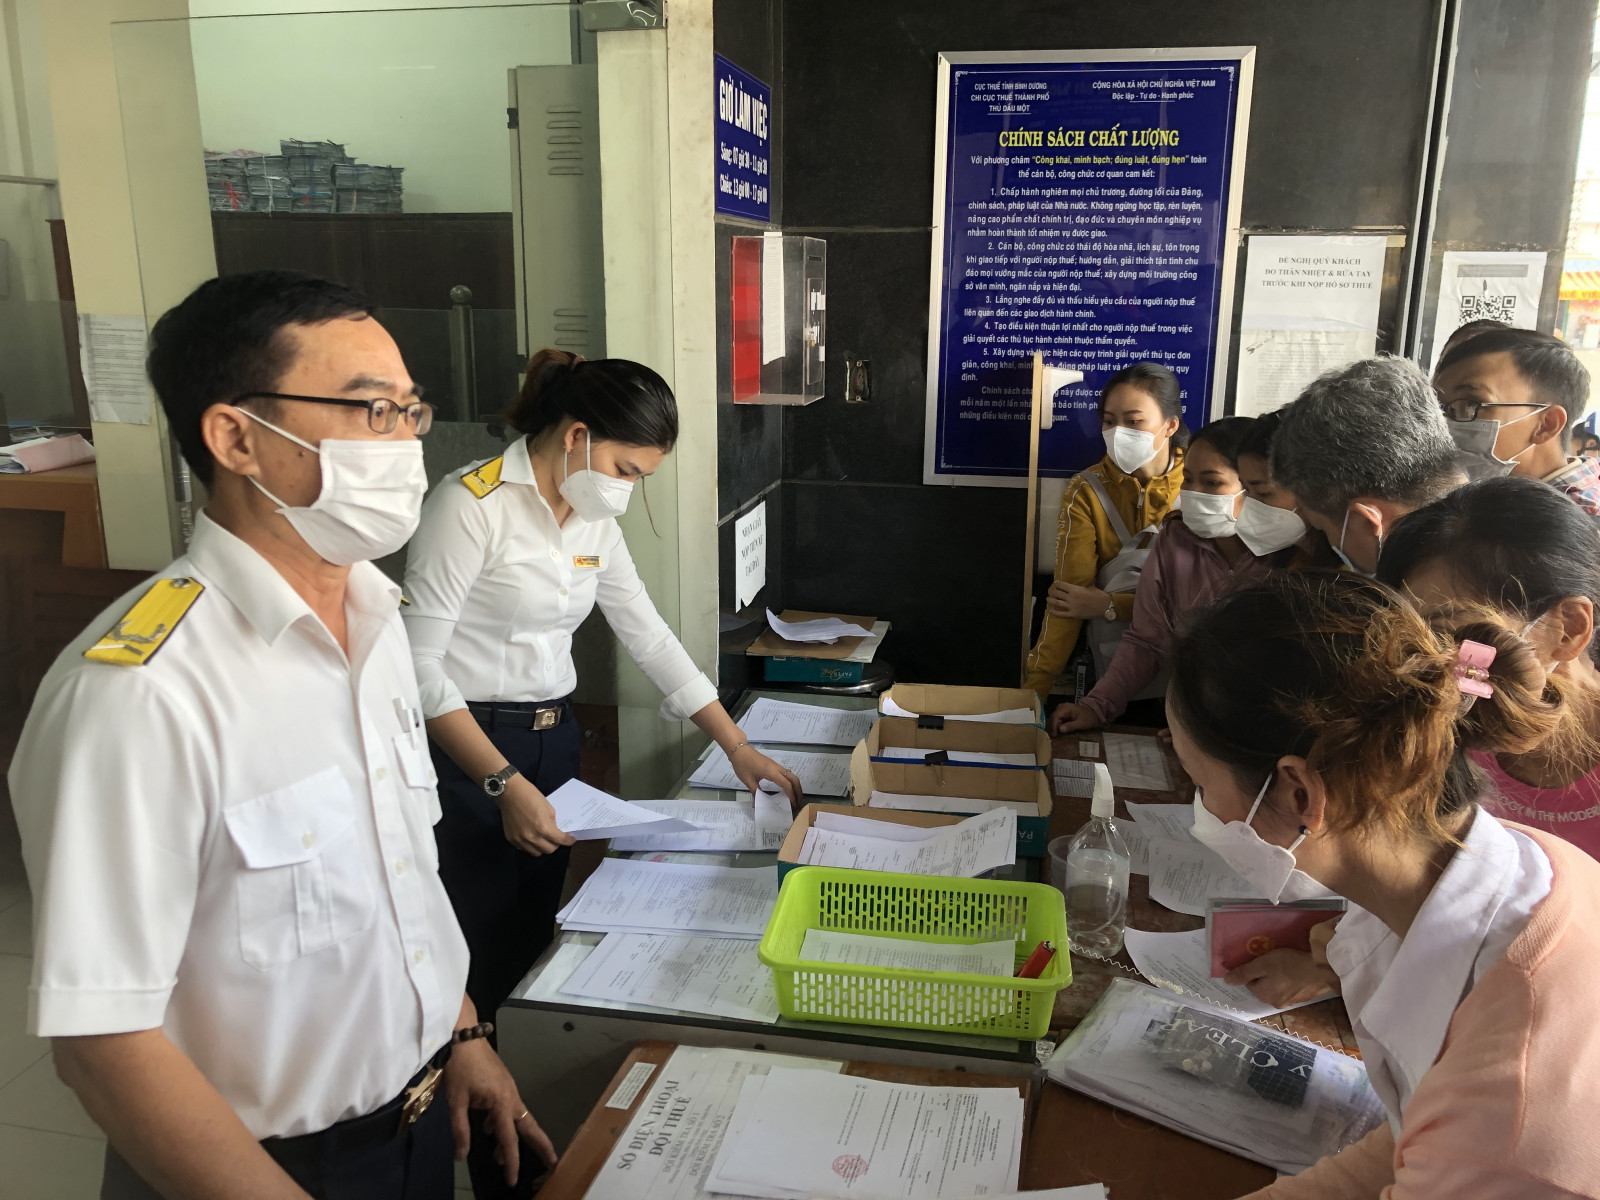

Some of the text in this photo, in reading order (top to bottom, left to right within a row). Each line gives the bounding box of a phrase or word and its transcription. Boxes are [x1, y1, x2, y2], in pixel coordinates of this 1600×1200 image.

[1092, 80, 1110, 89] CỘNG
[1112, 81, 1125, 89] HÒA
[1126, 79, 1135, 88] XÃ
[1136, 79, 1148, 89] HỘI
[1149, 79, 1163, 88] CHỦ
[1164, 79, 1184, 88] NGHĨA
[1185, 78, 1200, 88] VIỆT
[719, 74, 768, 147] GIỜ LÀM VIỆC
[998, 124, 1179, 149] CHÍNH SÁCH CHẤT LƯỢNG
[967, 226, 1107, 239] nhằm hoàn thành tốt nhiệm vụ được giao.
[1291, 258, 1311, 266] NGHỊ
[1332, 257, 1361, 266] KHÁCH
[1302, 268, 1326, 278] NHIỆT
[1308, 280, 1324, 289] NỘP
[1500, 795, 1525, 817] OGY
[1538, 810, 1555, 822] THE
[617, 1152, 636, 1171] SỐ
[628, 1120, 656, 1151] ĐIỆN
[648, 1080, 680, 1117] THOẠI
[648, 1096, 692, 1157] ĐỘI THUẾ
